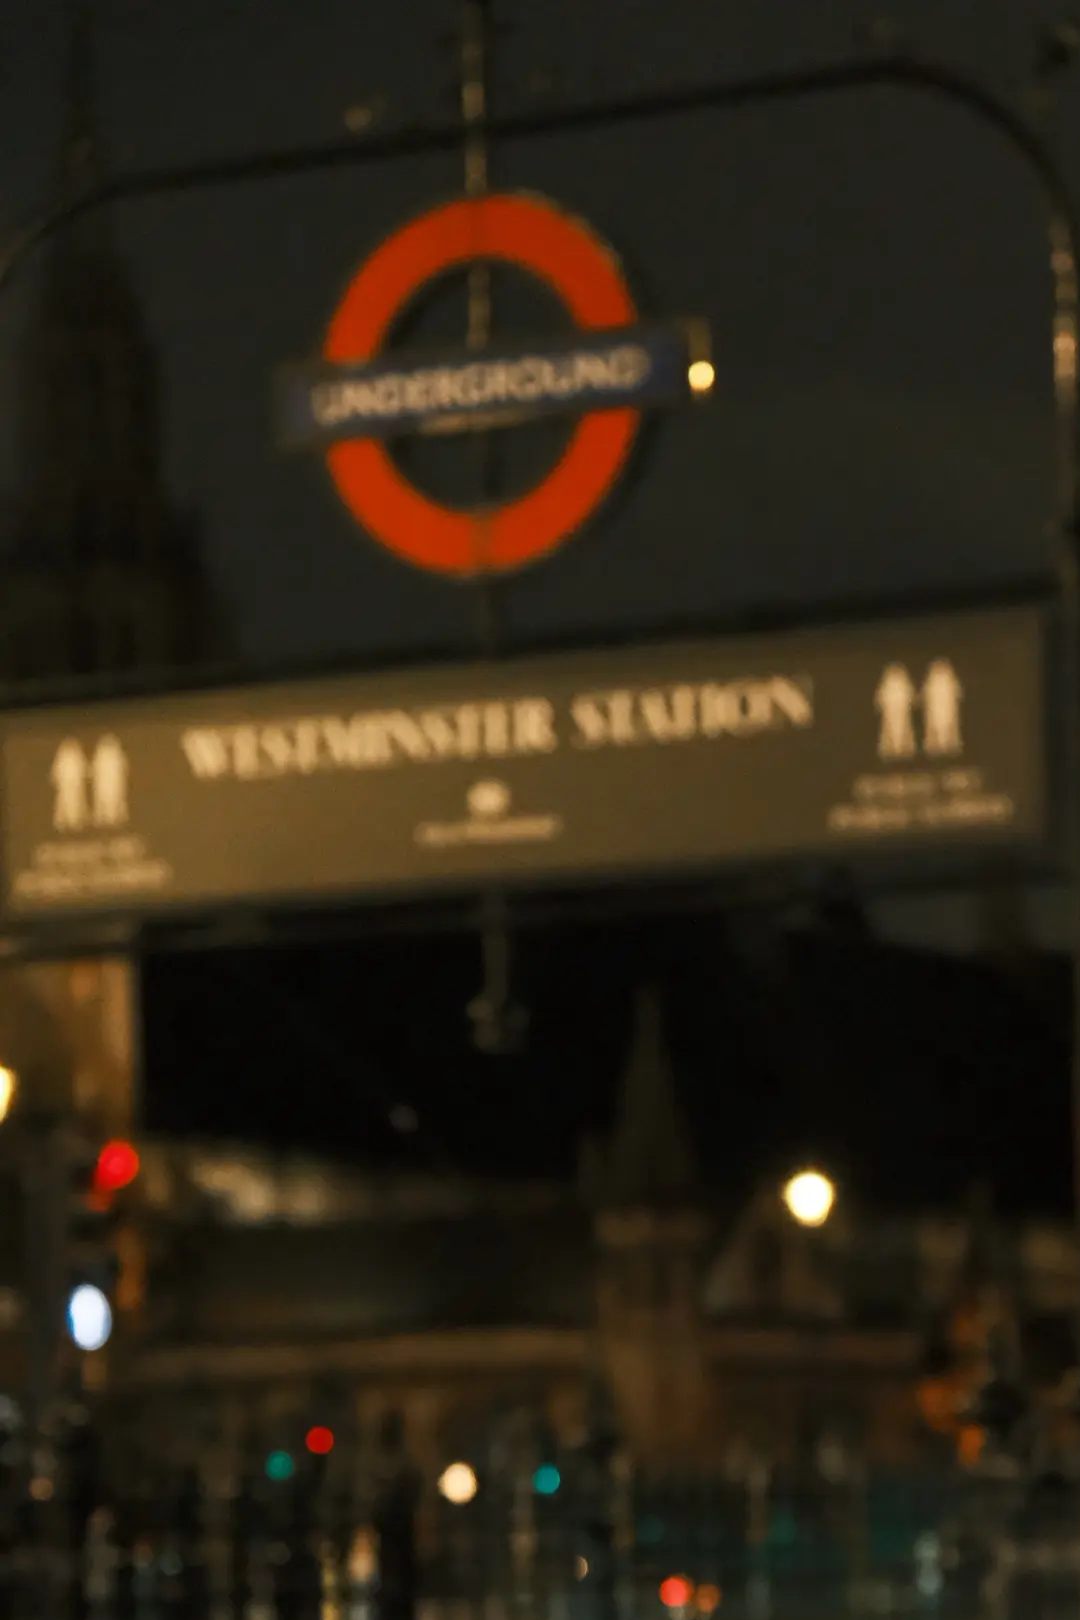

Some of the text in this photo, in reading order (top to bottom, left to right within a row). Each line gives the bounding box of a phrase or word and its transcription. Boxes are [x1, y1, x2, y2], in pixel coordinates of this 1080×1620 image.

[312, 345, 652, 425] UNDERGROUND
[181, 672, 813, 779] WESTMINSTER STATION
